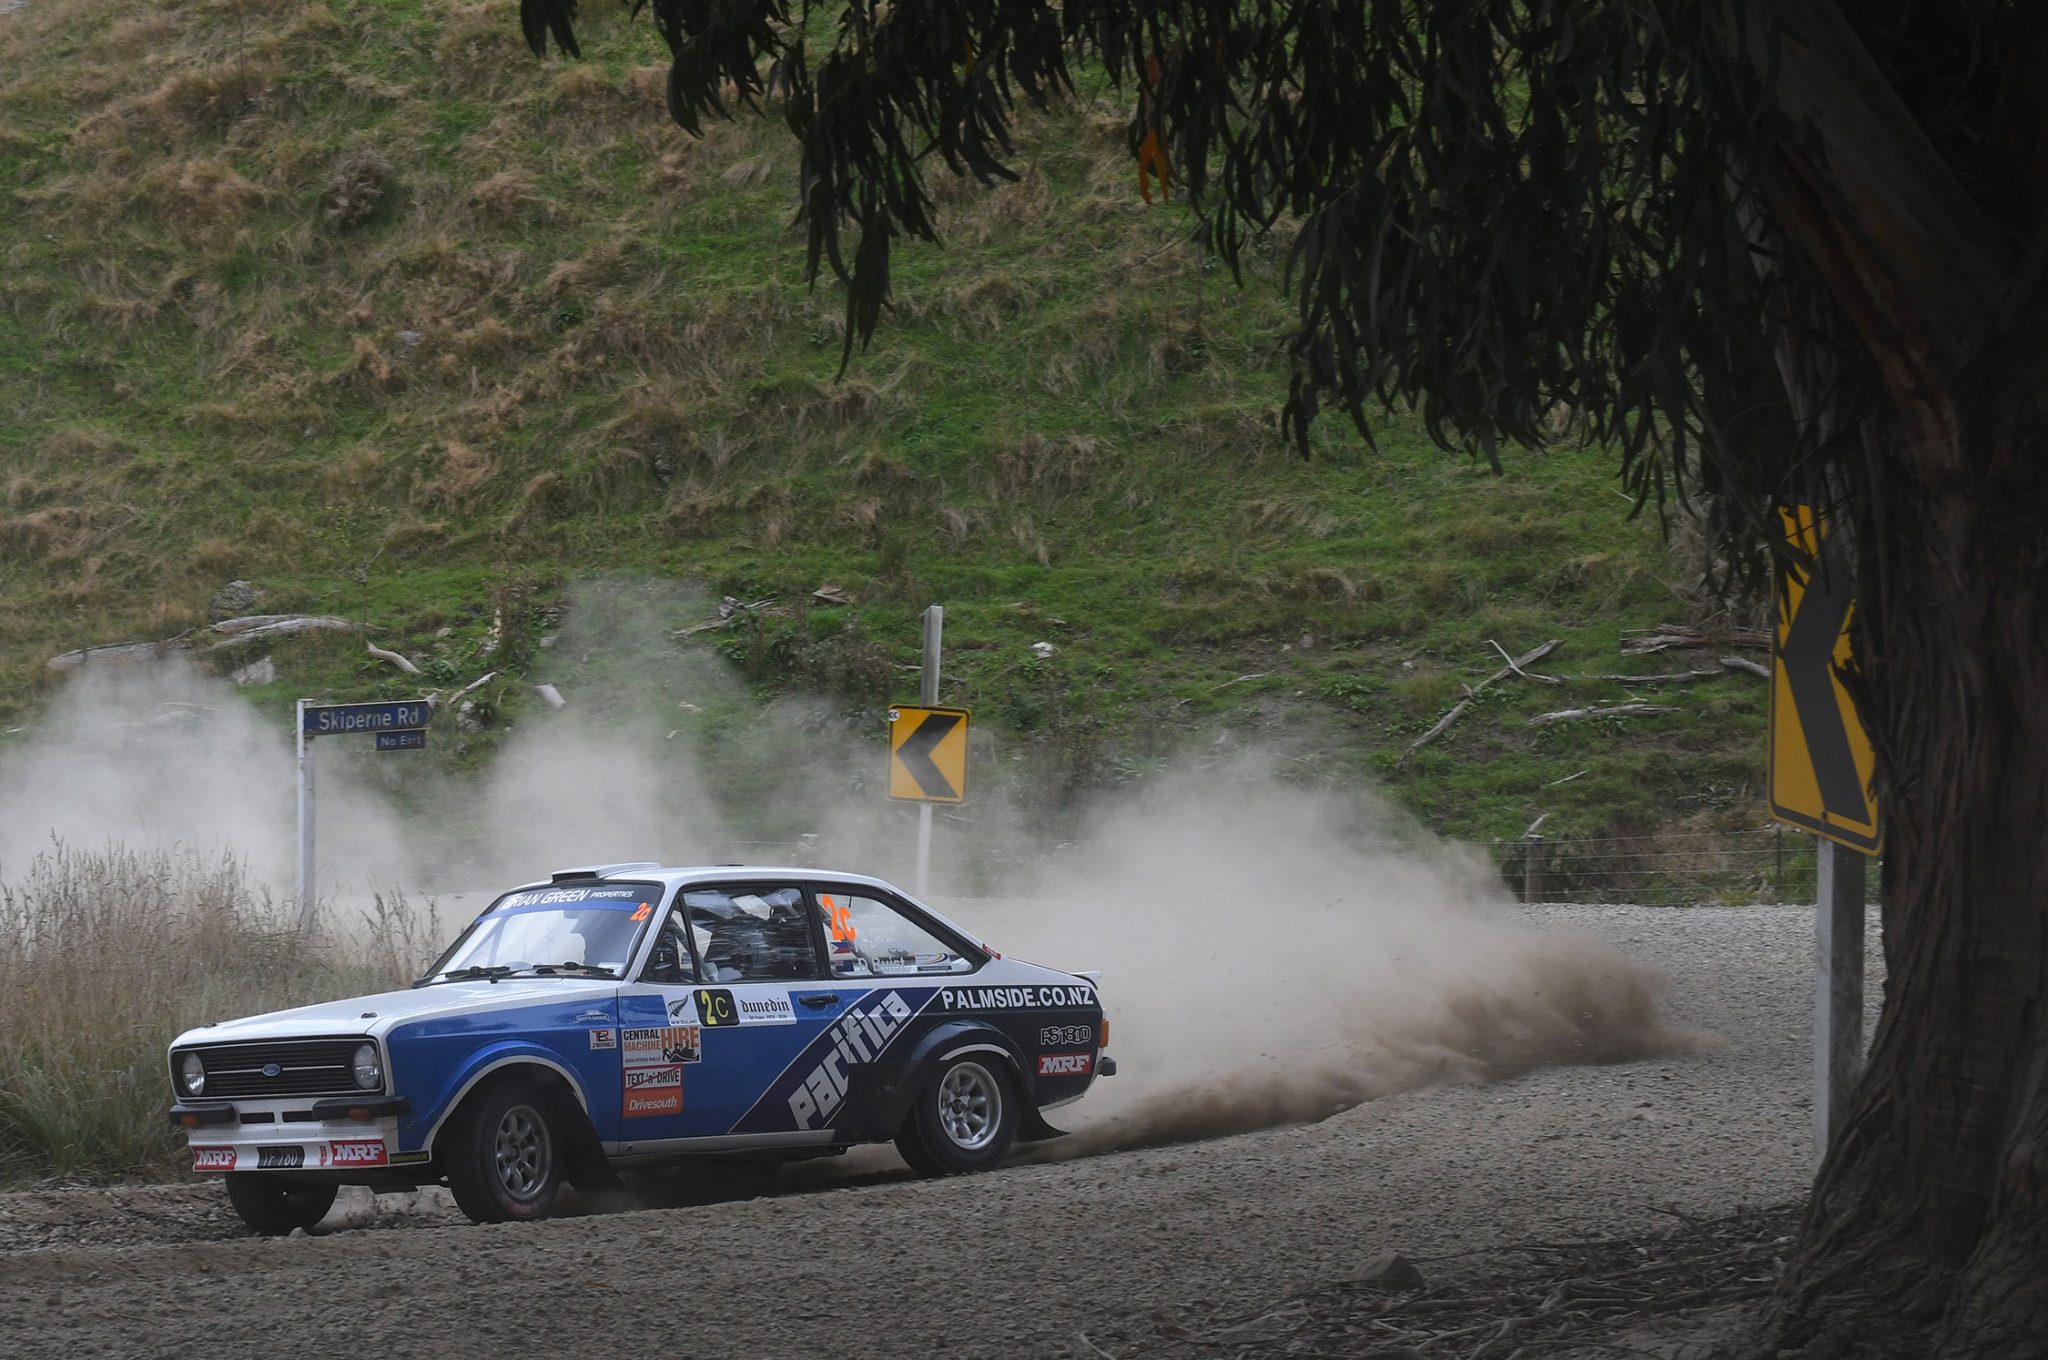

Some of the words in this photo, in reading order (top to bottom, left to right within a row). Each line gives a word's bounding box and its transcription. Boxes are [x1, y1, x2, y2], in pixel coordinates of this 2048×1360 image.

[319, 710, 392, 731] Skiperne
[397, 706, 420, 725] Rd
[380, 736, 396, 747] No
[541, 890, 590, 905] GREEN
[590, 890, 635, 898] PROPERTIES
[941, 985, 1094, 1010] PALMSIDE.CO.NZ
[624, 1029, 660, 1041] CENTRAL
[660, 1026, 700, 1050] HIRE
[624, 1040, 661, 1052] MACHINE
[1040, 1054, 1090, 1075] MRF
[627, 1072, 645, 1085] TEXT
[656, 1069, 680, 1084] DRIVE
[628, 1095, 678, 1112] Drivesouth
[196, 1149, 234, 1166] MRF
[334, 1143, 383, 1161] MRF
